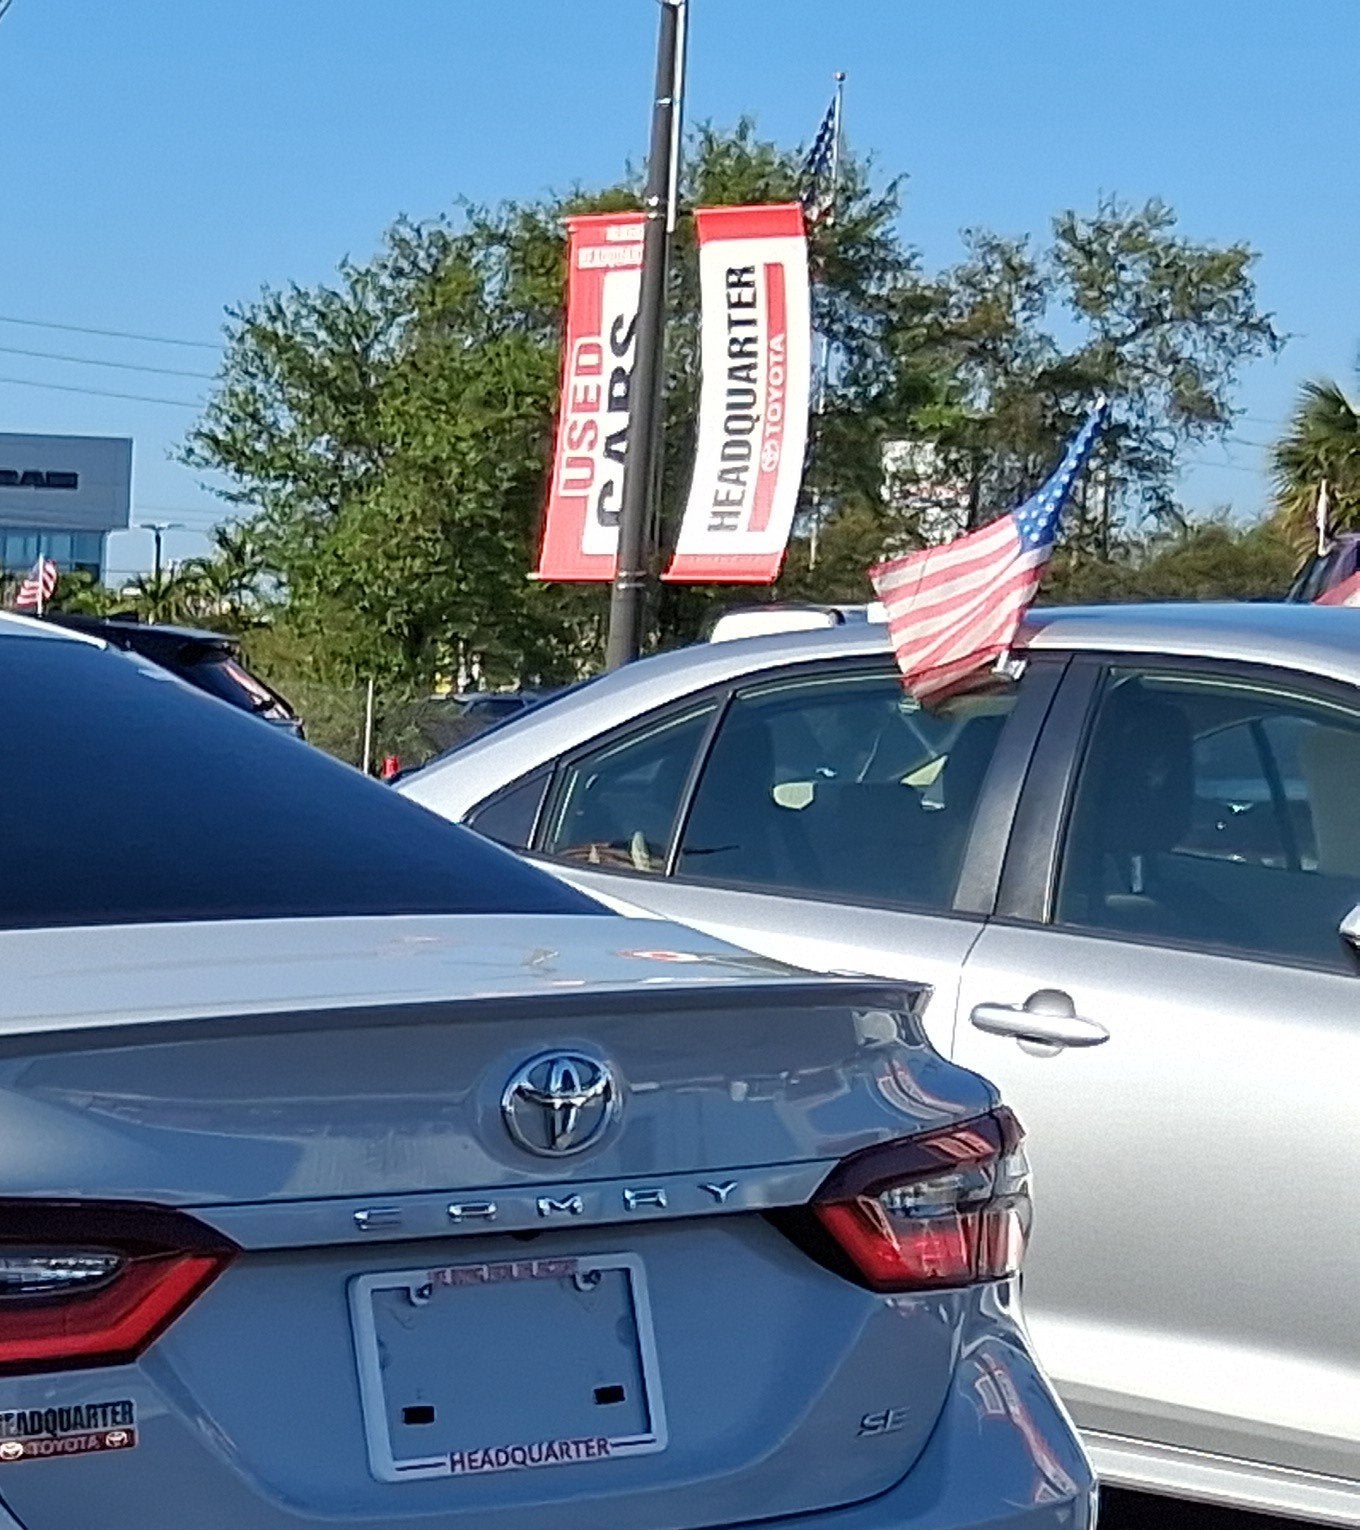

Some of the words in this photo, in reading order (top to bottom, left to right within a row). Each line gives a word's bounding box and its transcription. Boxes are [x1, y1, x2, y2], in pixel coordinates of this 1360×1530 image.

[563, 342, 603, 490] USED
[597, 313, 640, 527] CARS
[707, 264, 761, 533] HEADQUARTER
[764, 334, 787, 439] TOYOTA
[26, 1435, 100, 1456] TOYOTA
[448, 1437, 611, 1473] HEADQUARTER
[856, 1407, 911, 1438] SE
